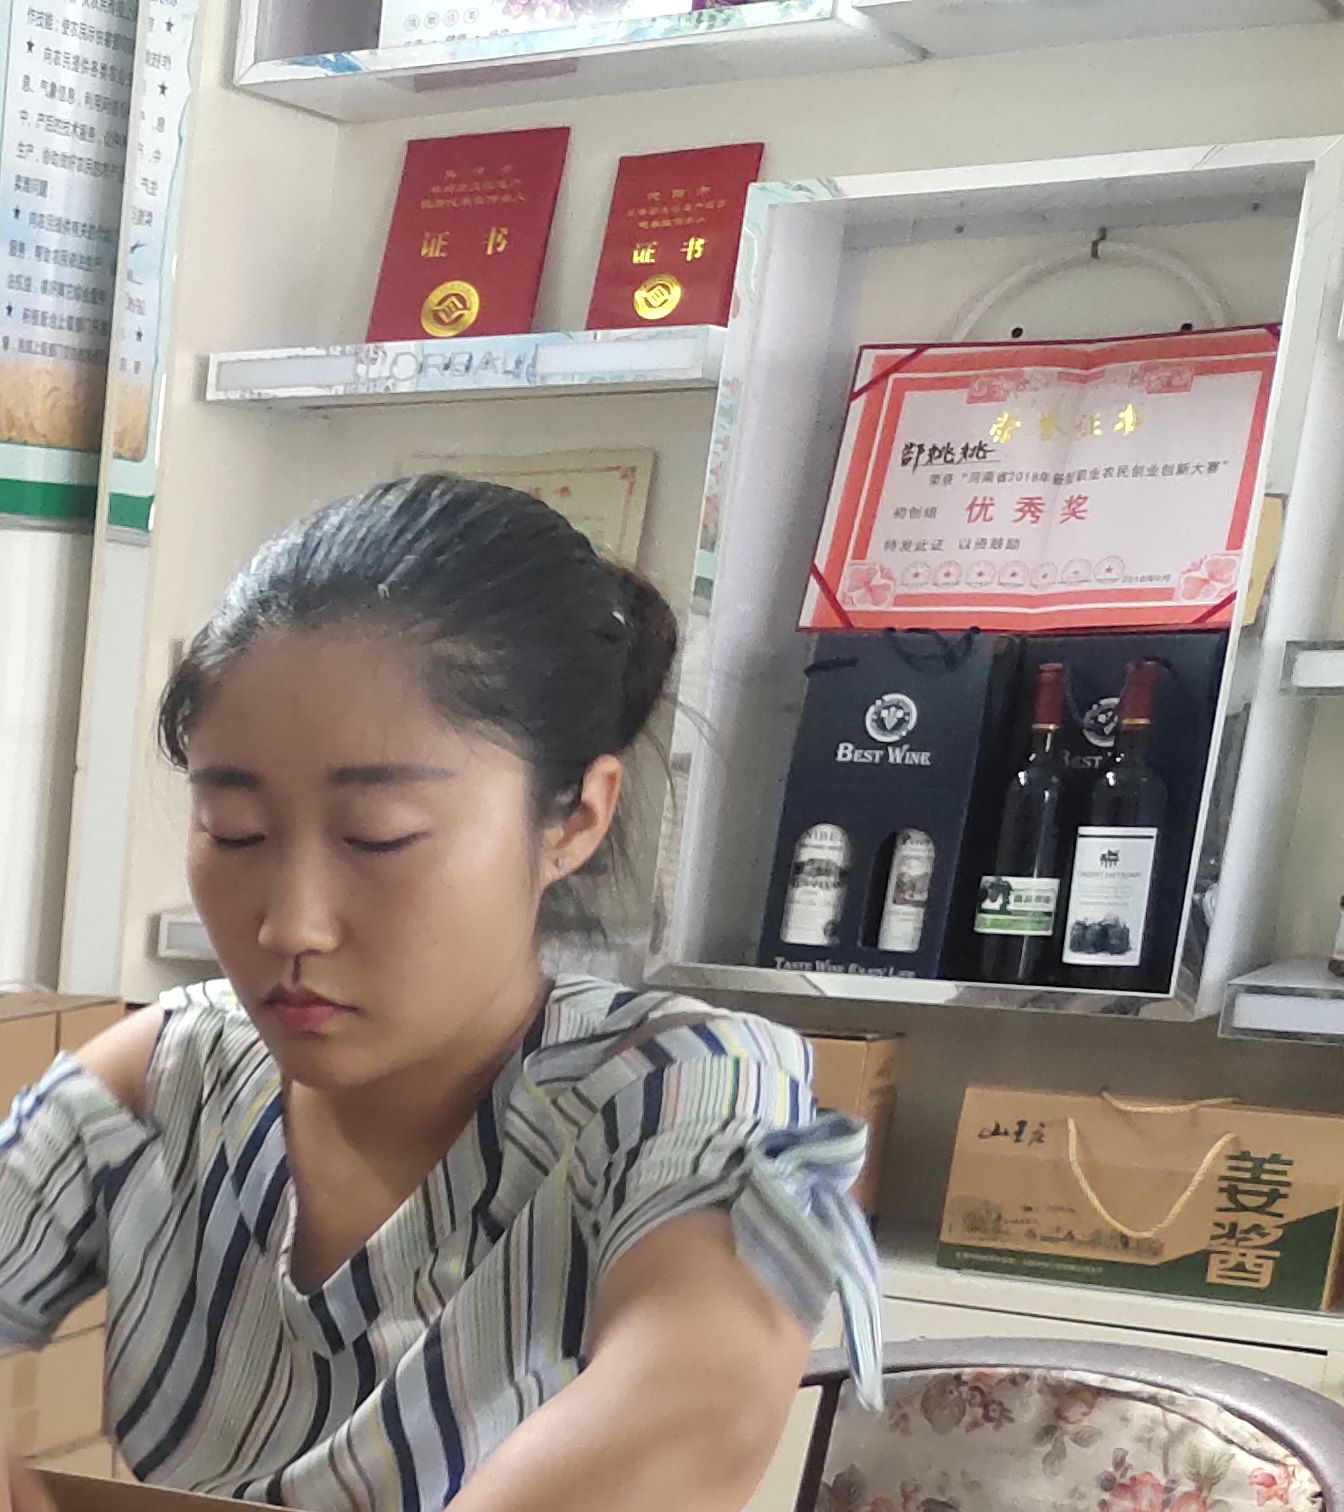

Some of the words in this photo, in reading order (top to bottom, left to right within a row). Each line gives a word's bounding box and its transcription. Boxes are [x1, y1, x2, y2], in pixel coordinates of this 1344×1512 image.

[632, 237, 708, 263] 证书
[965, 493, 1089, 525] 优秀奖
[835, 742, 884, 764] BEST
[888, 744, 931, 766] WINE
[1205, 1150, 1294, 1290] 姜酱
